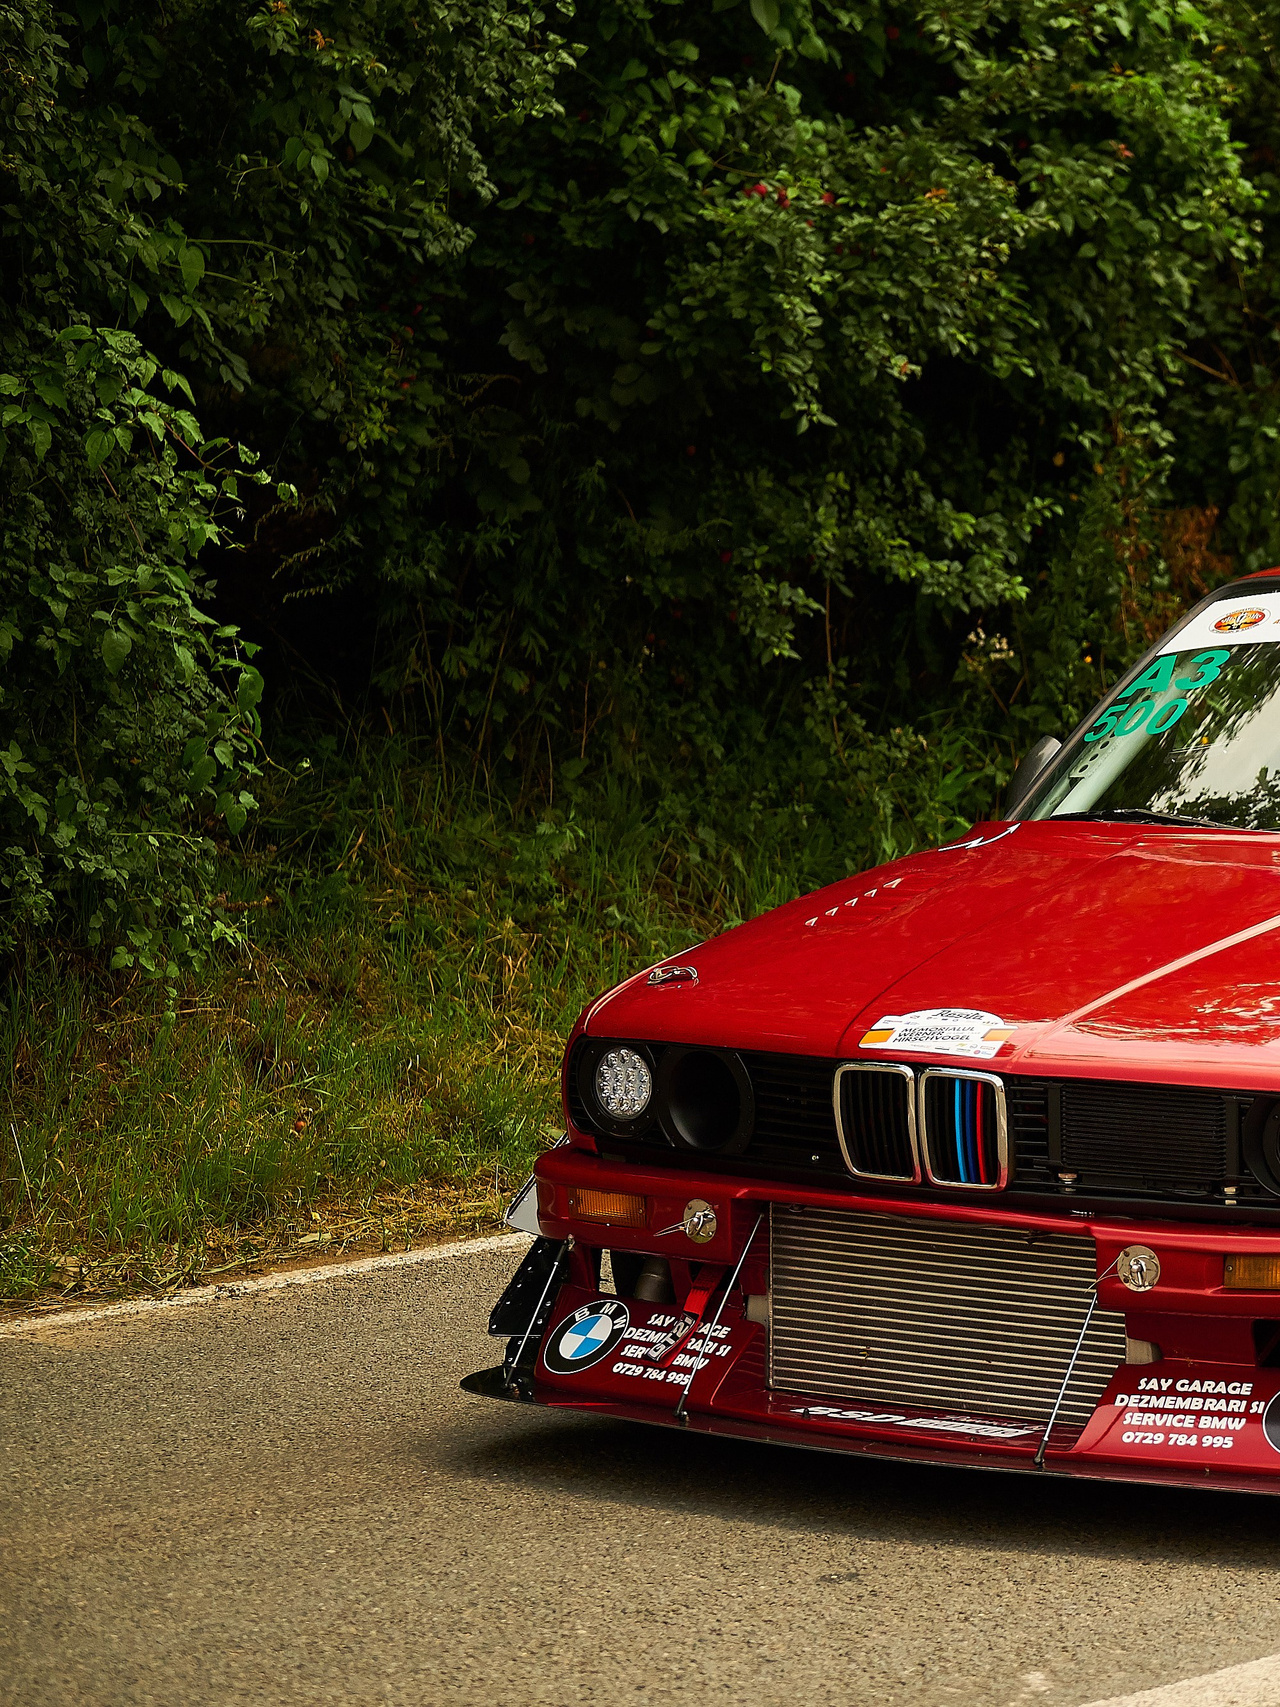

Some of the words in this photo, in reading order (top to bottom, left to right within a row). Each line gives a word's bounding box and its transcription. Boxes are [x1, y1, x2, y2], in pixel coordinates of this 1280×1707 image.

[1117, 650, 1230, 699] A3
[1084, 698, 1189, 742] 500
[893, 1035, 970, 1043] HIRSCHVOGEL
[575, 1303, 626, 1329] BMW
[647, 1313, 675, 1327] SAY
[715, 1344, 732, 1356] SI
[672, 1354, 709, 1369] BMW
[612, 1362, 644, 1376] 0729
[643, 1367, 667, 1380] 784
[666, 1371, 692, 1385] 995
[1137, 1377, 1173, 1391] SAY
[1175, 1379, 1253, 1395] GARAGE
[1114, 1394, 1247, 1413] DEZMEMBRARI
[1249, 1401, 1265, 1414] SI
[1122, 1412, 1196, 1428] SERVICE
[1198, 1416, 1246, 1430] BMW
[1122, 1431, 1165, 1444] 0729
[1167, 1433, 1197, 1446] 784
[1201, 1435, 1233, 1449] 995
